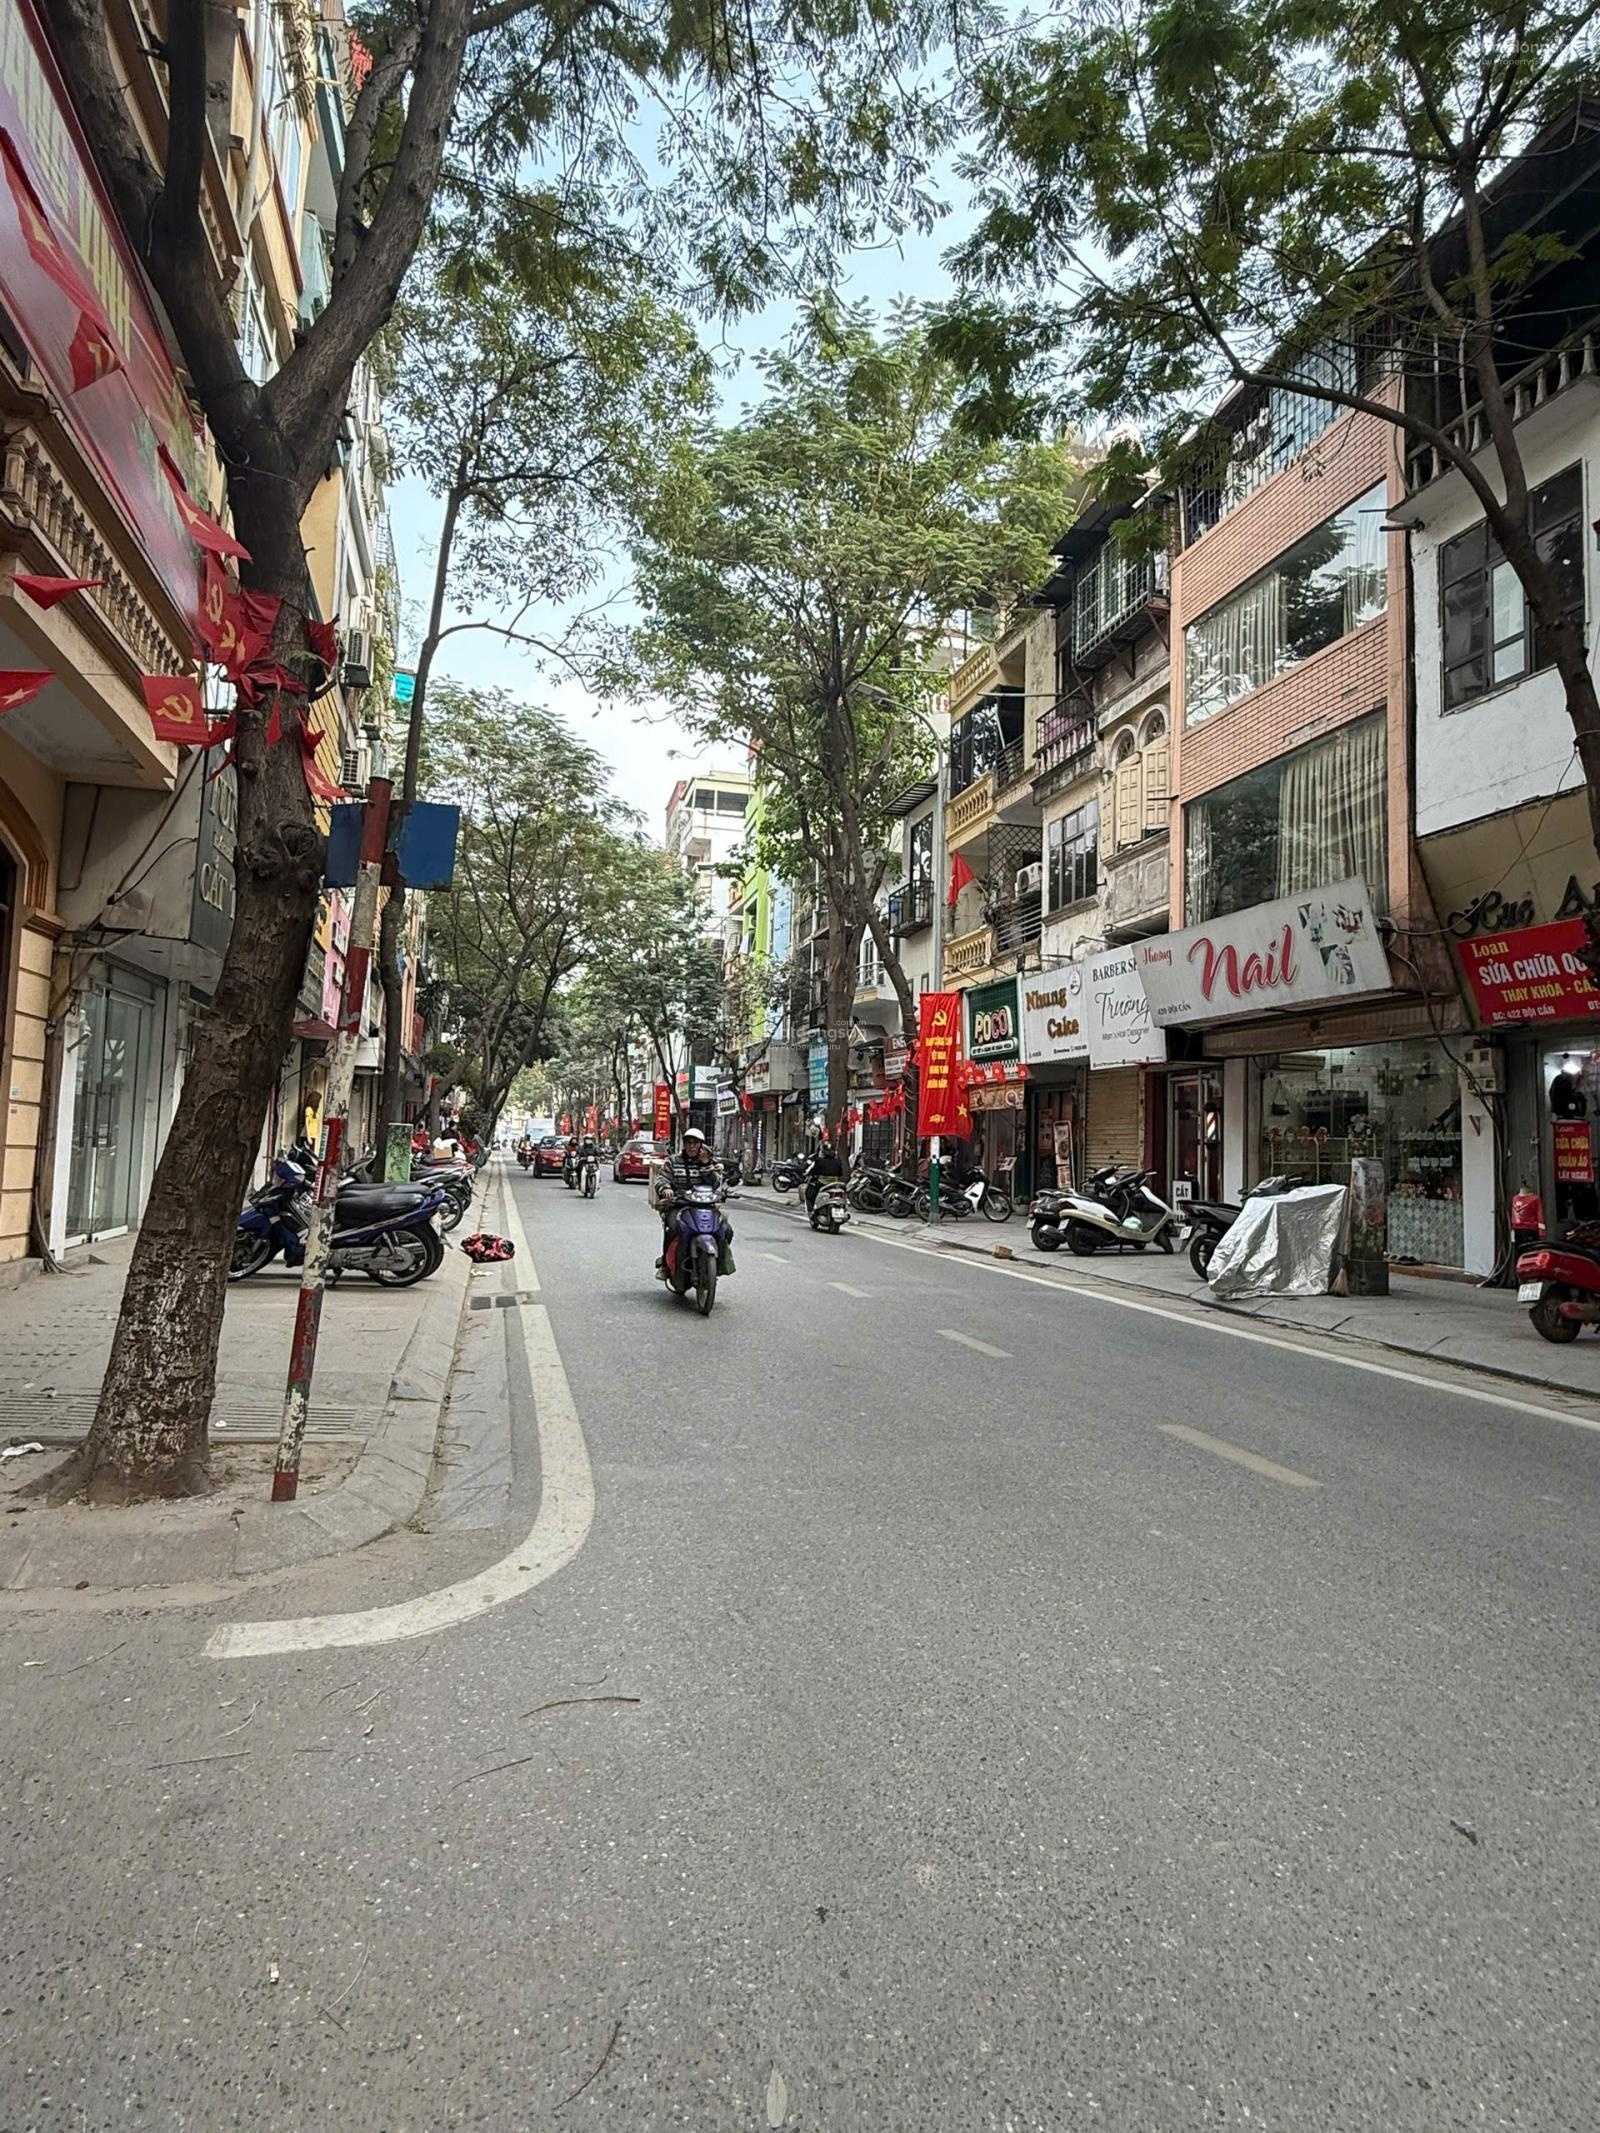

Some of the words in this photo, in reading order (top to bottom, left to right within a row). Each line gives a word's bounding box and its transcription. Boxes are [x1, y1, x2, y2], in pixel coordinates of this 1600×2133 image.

[1187, 923, 1298, 1001] Nail
[1470, 941, 1510, 958] Loan
[1092, 960, 1128, 982] BARBER
[1478, 958, 1513, 986] SỬA
[1513, 953, 1561, 981] CHỮA
[1025, 987, 1067, 1012] Nhung
[1501, 987, 1529, 1003] THAY
[1530, 979, 1564, 1000] KHÓA
[975, 1007, 1012, 1043] POCO
[1047, 1015, 1080, 1040] Cake
